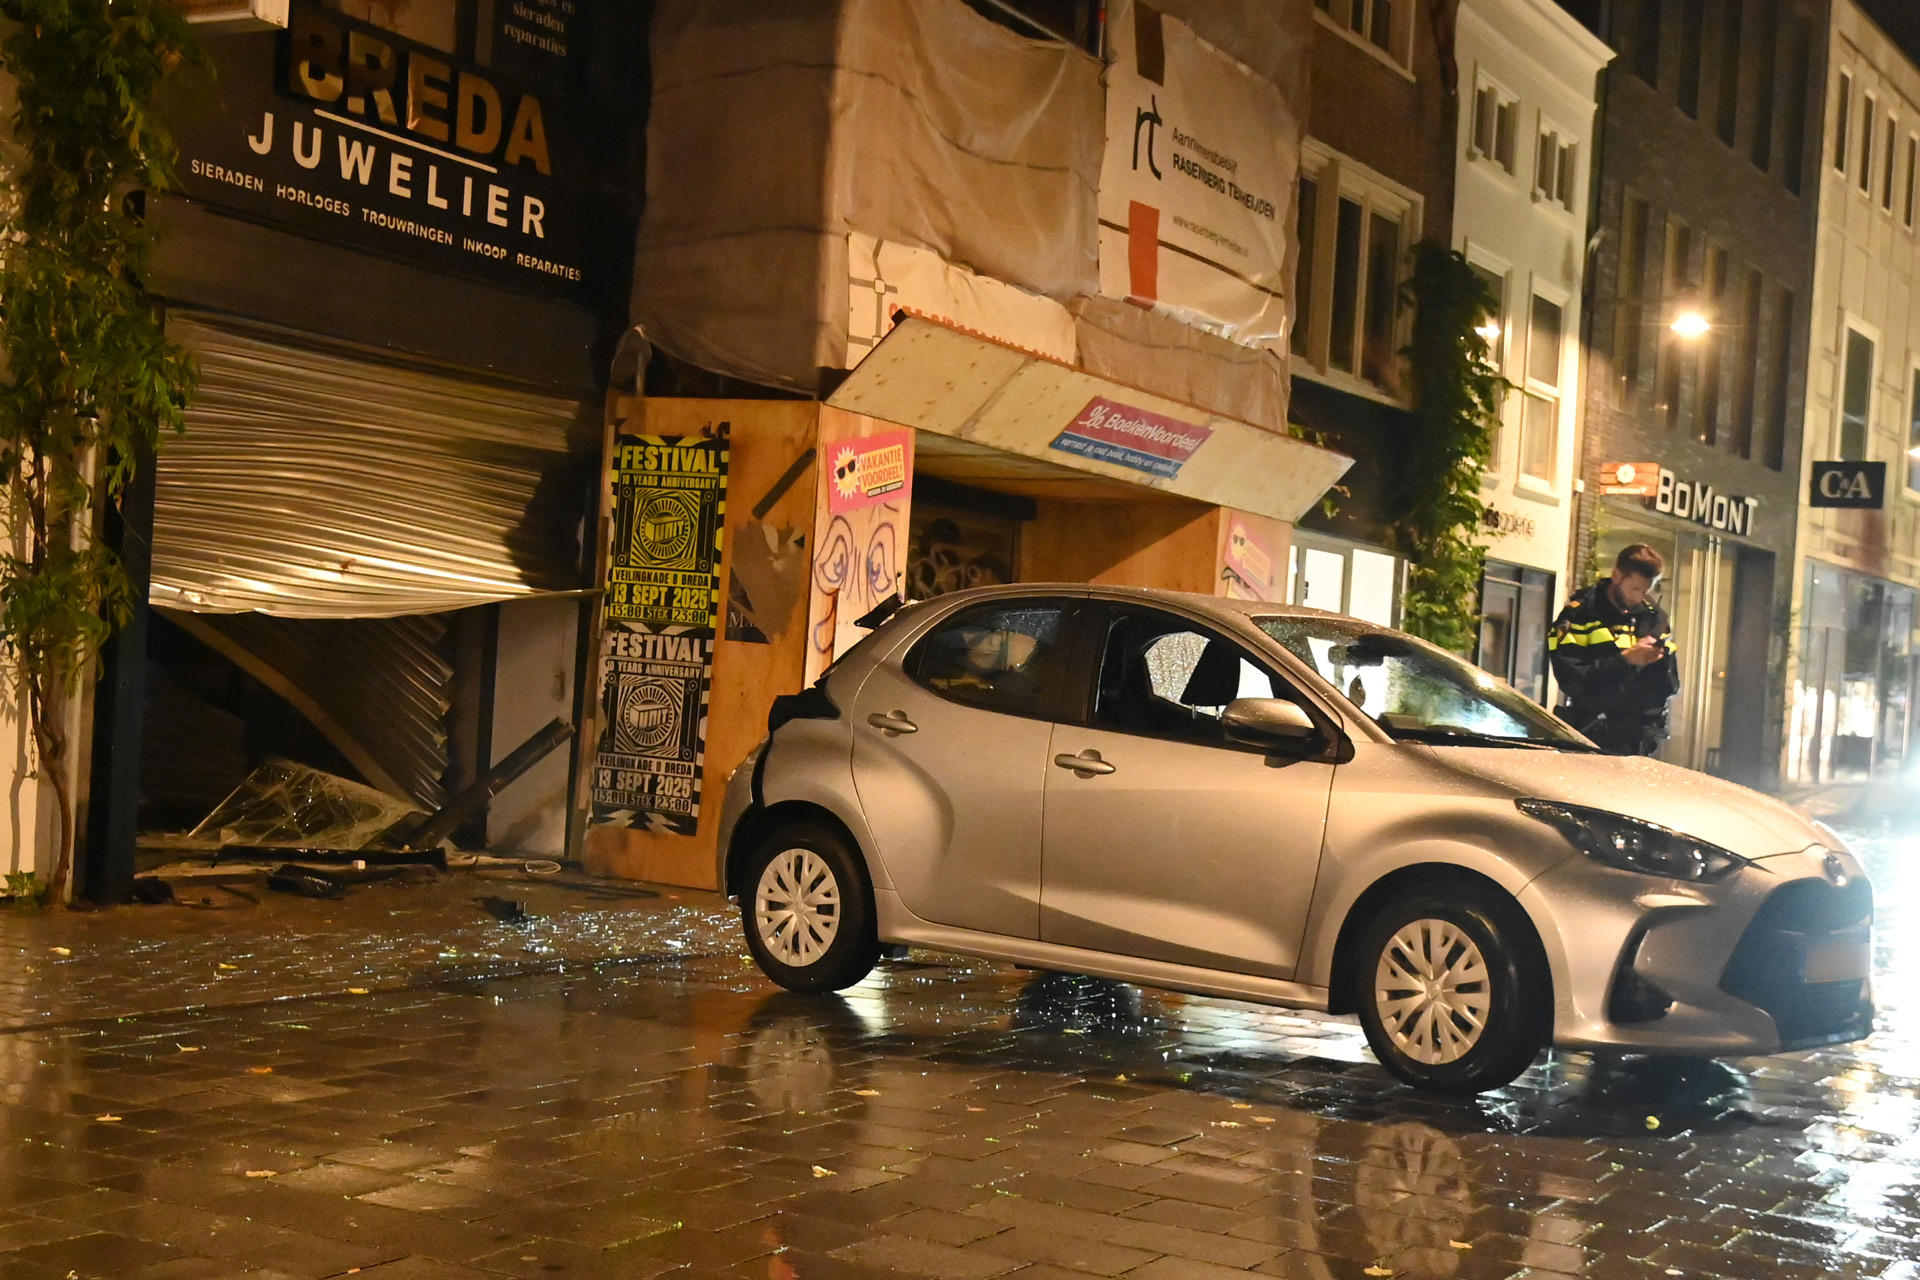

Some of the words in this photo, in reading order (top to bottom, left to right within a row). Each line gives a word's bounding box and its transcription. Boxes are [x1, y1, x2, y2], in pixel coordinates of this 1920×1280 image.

[513, 2, 565, 33] sieraden
[504, 23, 567, 57] reparaties
[291, 20, 551, 176] BREDA
[248, 112, 545, 238] JUWELIER
[191, 159, 264, 192] SIERADEN
[276, 184, 350, 216] HORLOGES
[362, 208, 453, 245] TROUWRINGEN
[463, 237, 507, 260] INKOOP
[517, 253, 582, 281] REPARATIES
[1104, 413, 1203, 451] BoekenVoordeel
[621, 445, 720, 473] FESTIVAL
[861, 448, 902, 472] VAKANTIE
[622, 474, 630, 485] 10
[633, 474, 658, 486] YEARS
[661, 476, 717, 489] ANNIVERSARY
[861, 465, 903, 487] VOORDEEL!
[615, 567, 669, 584] VEILINGKADE
[673, 573, 678, 585] 8
[682, 574, 708, 587] BREDA
[614, 583, 627, 603] 13
[632, 584, 668, 606] SEPT
[673, 588, 708, 609] 2025
[612, 604, 643, 617] 13:00
[673, 610, 706, 623] 23:00
[602, 631, 703, 662] FESTIVAL
[618, 661, 643, 674] YEARS
[645, 664, 700, 679] ANNIVERSARY
[600, 753, 653, 771] VEILINGKADE
[665, 762, 692, 776] BREDA
[599, 769, 612, 788] 13
[616, 770, 651, 793] SEPT
[656, 775, 691, 798] 2025
[656, 797, 689, 812] 23:00
